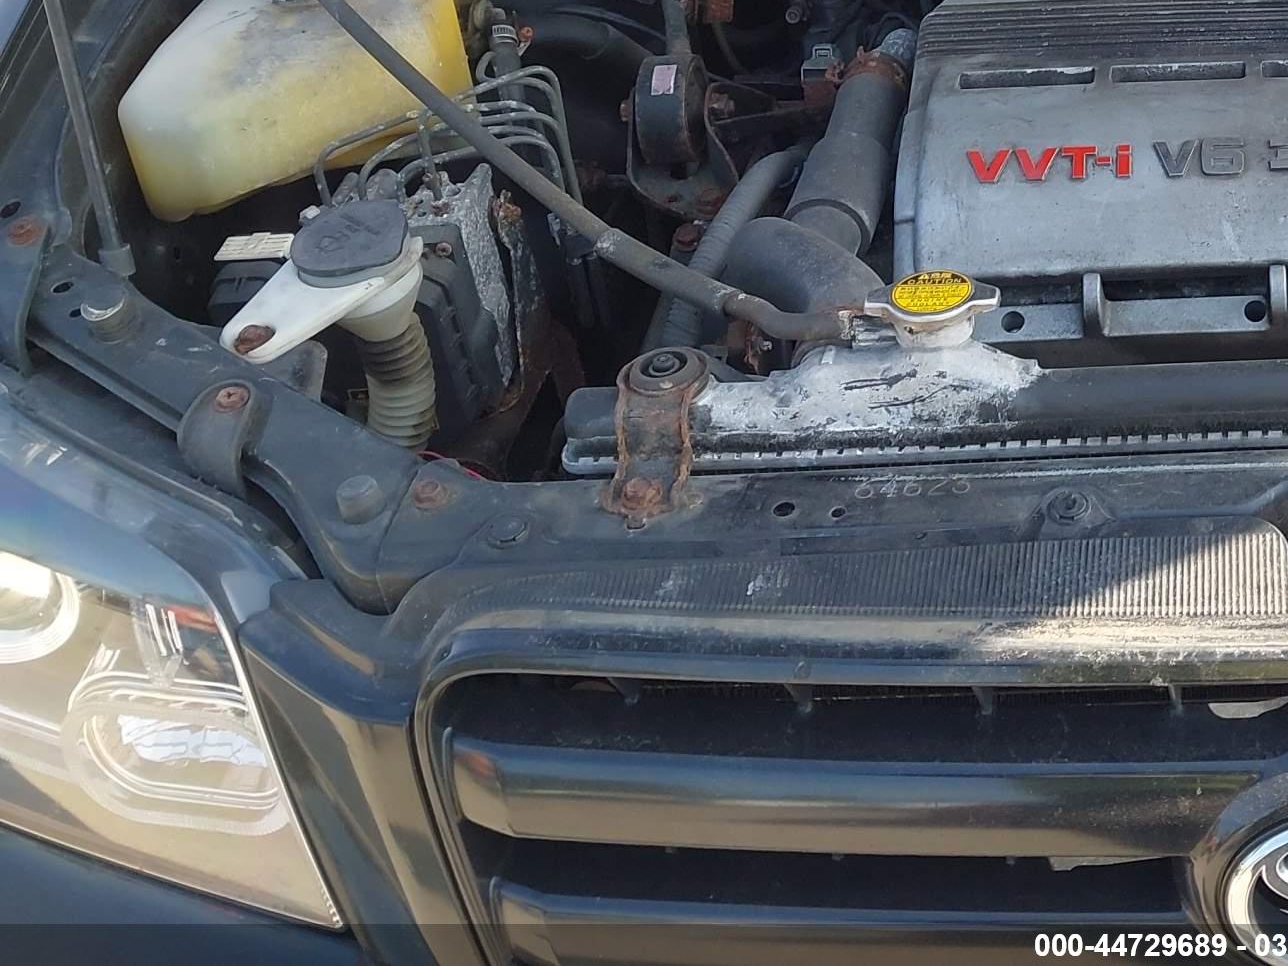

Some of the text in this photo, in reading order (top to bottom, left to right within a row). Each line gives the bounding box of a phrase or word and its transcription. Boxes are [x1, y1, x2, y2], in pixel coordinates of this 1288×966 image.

[966, 143, 1134, 185] VVT-i
[1152, 136, 1248, 178] V6
[907, 277, 962, 286] CAUTION
